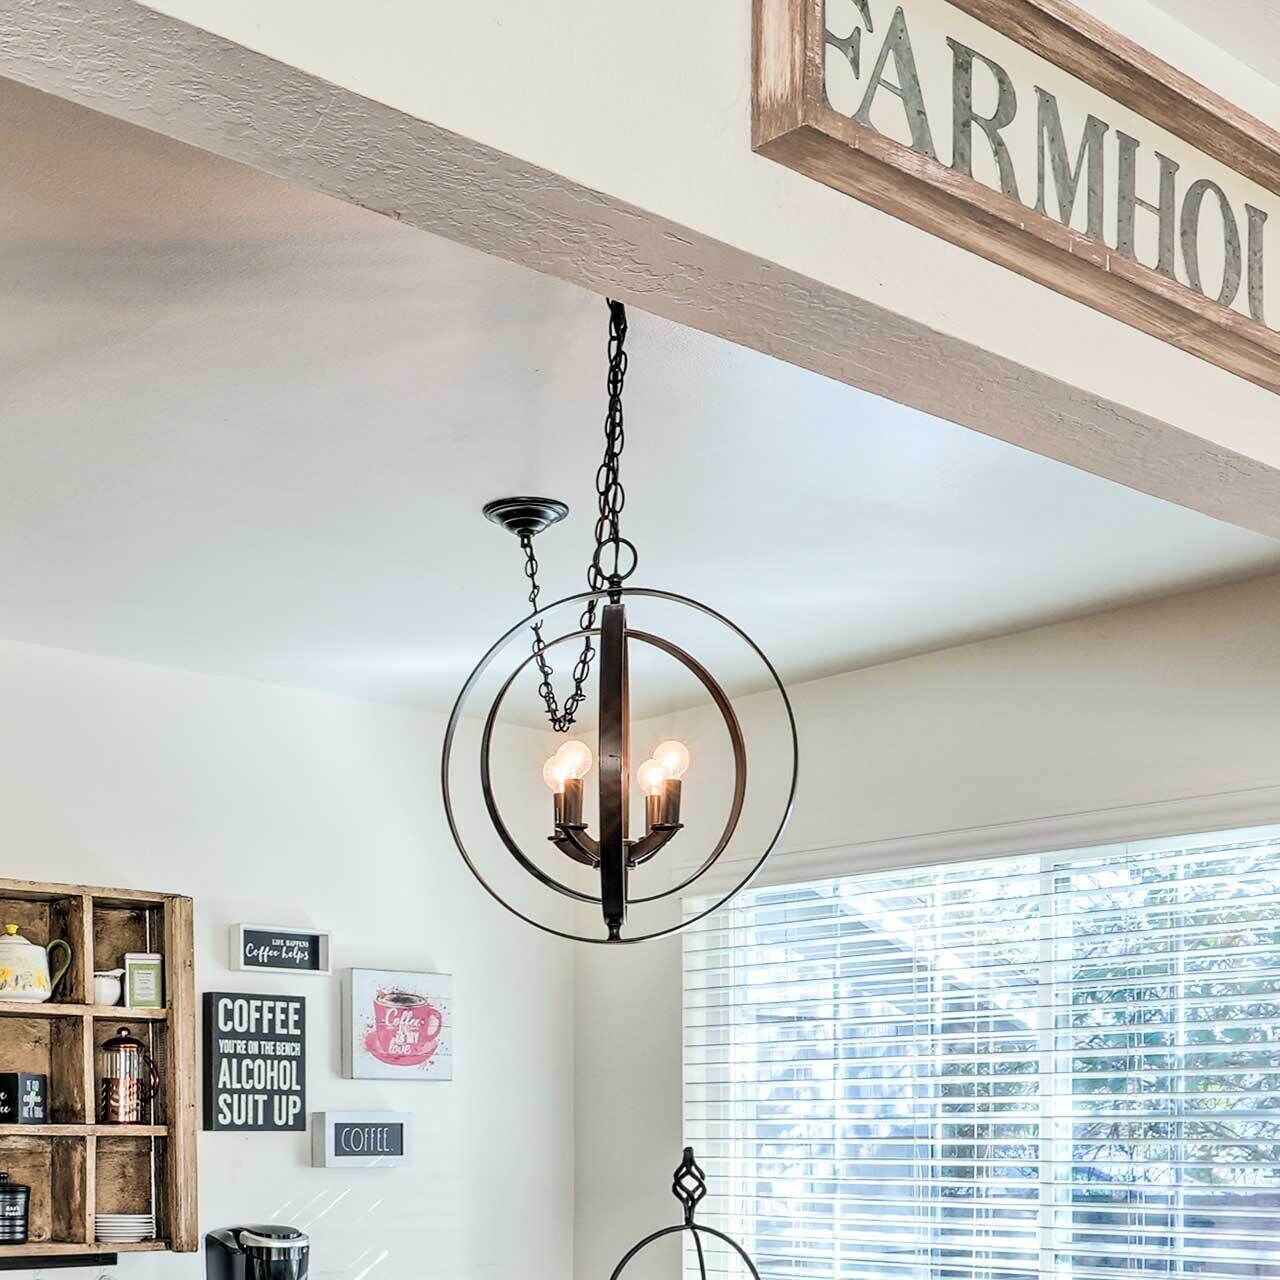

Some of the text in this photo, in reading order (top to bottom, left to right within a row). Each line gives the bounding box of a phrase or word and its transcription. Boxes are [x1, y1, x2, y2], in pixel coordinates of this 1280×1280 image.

[245, 943, 309, 964] Coffee helps
[218, 998, 301, 1035] COFFEE
[385, 1008, 421, 1034] Coffee
[218, 1039, 301, 1056] YOU'RE ON THE BENCH
[218, 1058, 301, 1091] ALCOHOL
[218, 1093, 301, 1125] SUIT UP
